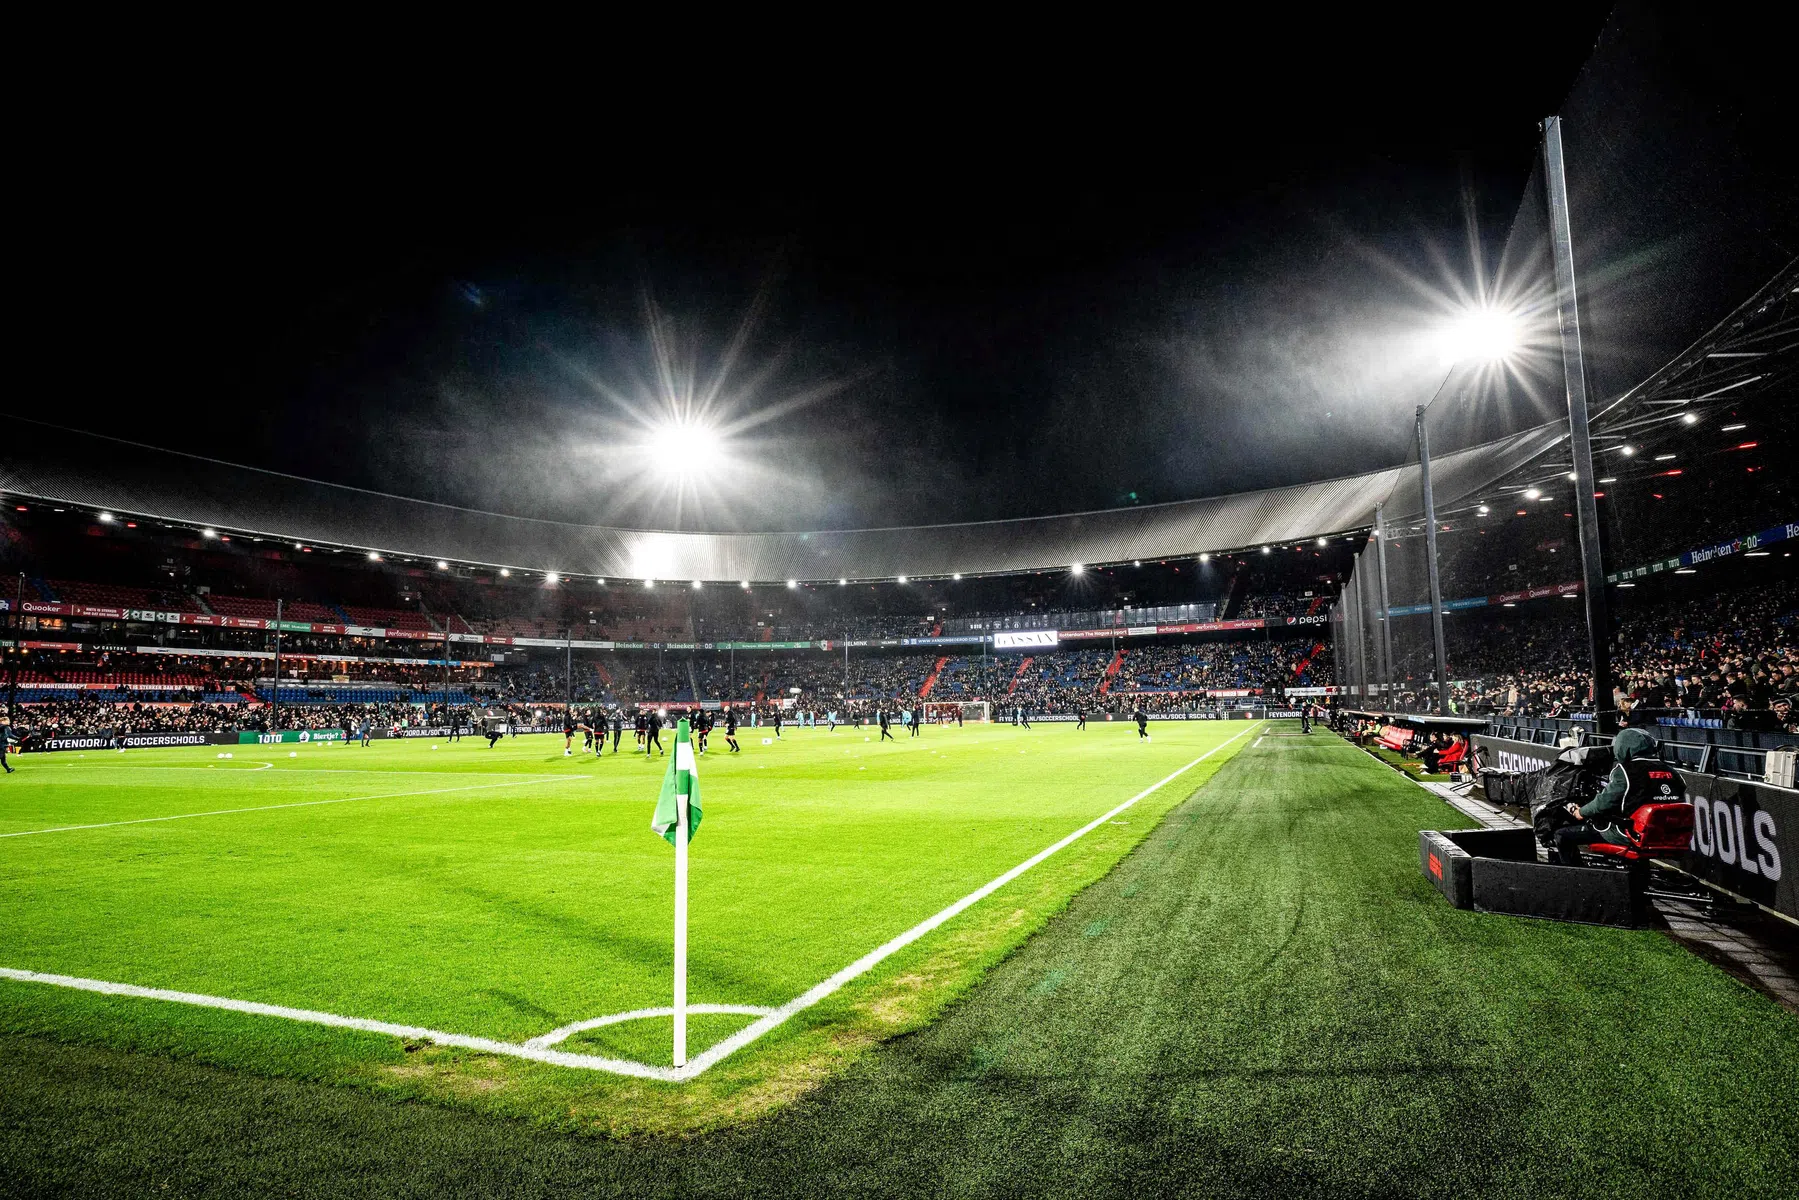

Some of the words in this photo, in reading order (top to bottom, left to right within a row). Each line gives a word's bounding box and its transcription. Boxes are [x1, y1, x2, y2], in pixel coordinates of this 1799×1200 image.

[1558, 583, 1578, 593] Quooker
[1500, 594, 1521, 603] Quooker
[1529, 589, 1550, 598] Quooker
[23, 602, 61, 613] Quooker
[1299, 614, 1328, 625] pepsi
[258, 734, 283, 744] TOTO
